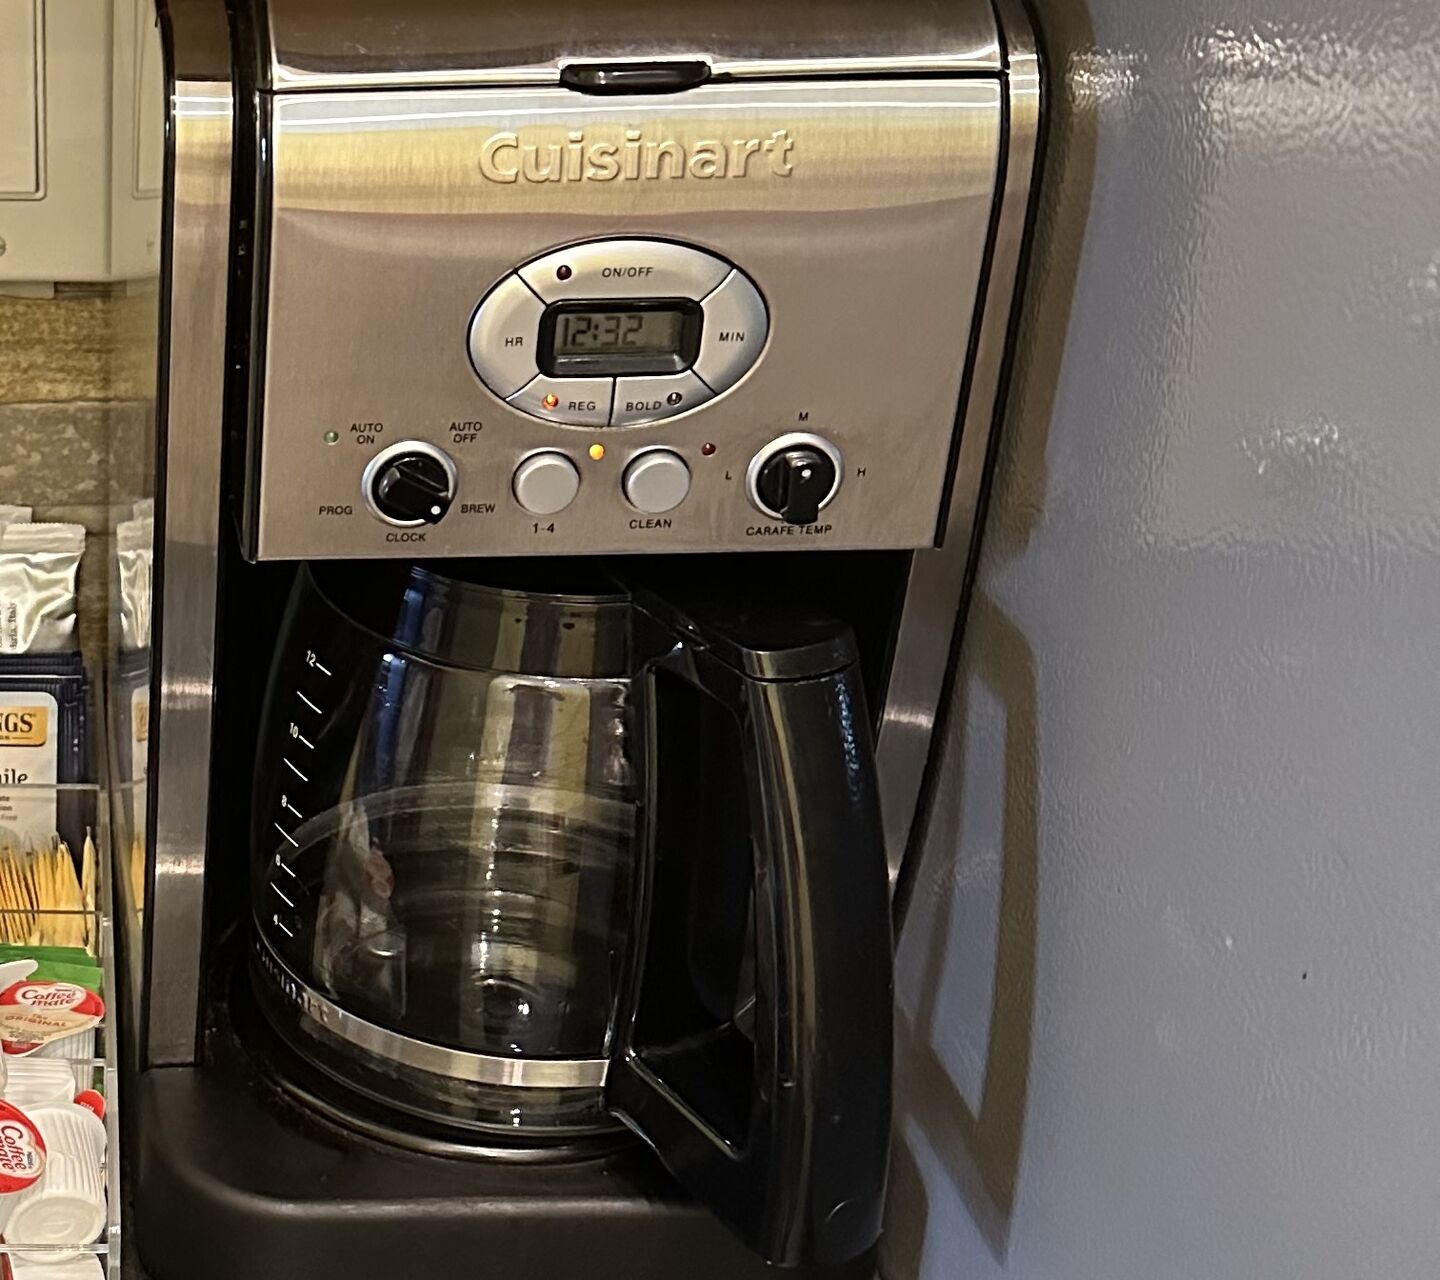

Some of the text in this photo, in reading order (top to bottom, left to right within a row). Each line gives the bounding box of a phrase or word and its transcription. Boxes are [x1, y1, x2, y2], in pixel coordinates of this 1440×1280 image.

[479, 129, 794, 183] Cuisinart
[601, 266, 654, 278] ON/OFF
[562, 314, 642, 347] 12:32
[505, 337, 523, 347] HR
[718, 332, 745, 342] MIN
[568, 401, 596, 411] REG
[625, 401, 662, 412] BOLD
[798, 412, 809, 421] M
[350, 423, 384, 433] AUTO
[449, 422, 482, 432] AUTO
[356, 435, 375, 445] ON
[453, 433, 478, 443] OFF
[725, 471, 732, 480] L
[857, 468, 866, 477] H
[319, 505, 353, 516] PROG
[460, 504, 496, 514] BREW
[532, 523, 555, 534] 1-4
[629, 519, 672, 529] CLEAN
[746, 524, 833, 536] CARAFE TEMP
[386, 533, 427, 543] CLOCK
[305, 650, 316, 667] 12
[289, 722, 298, 738] 10
[21, 989, 77, 1001] Coffee
[30, 999, 75, 1007] mate
[1, 1125, 27, 1170] Coffee
